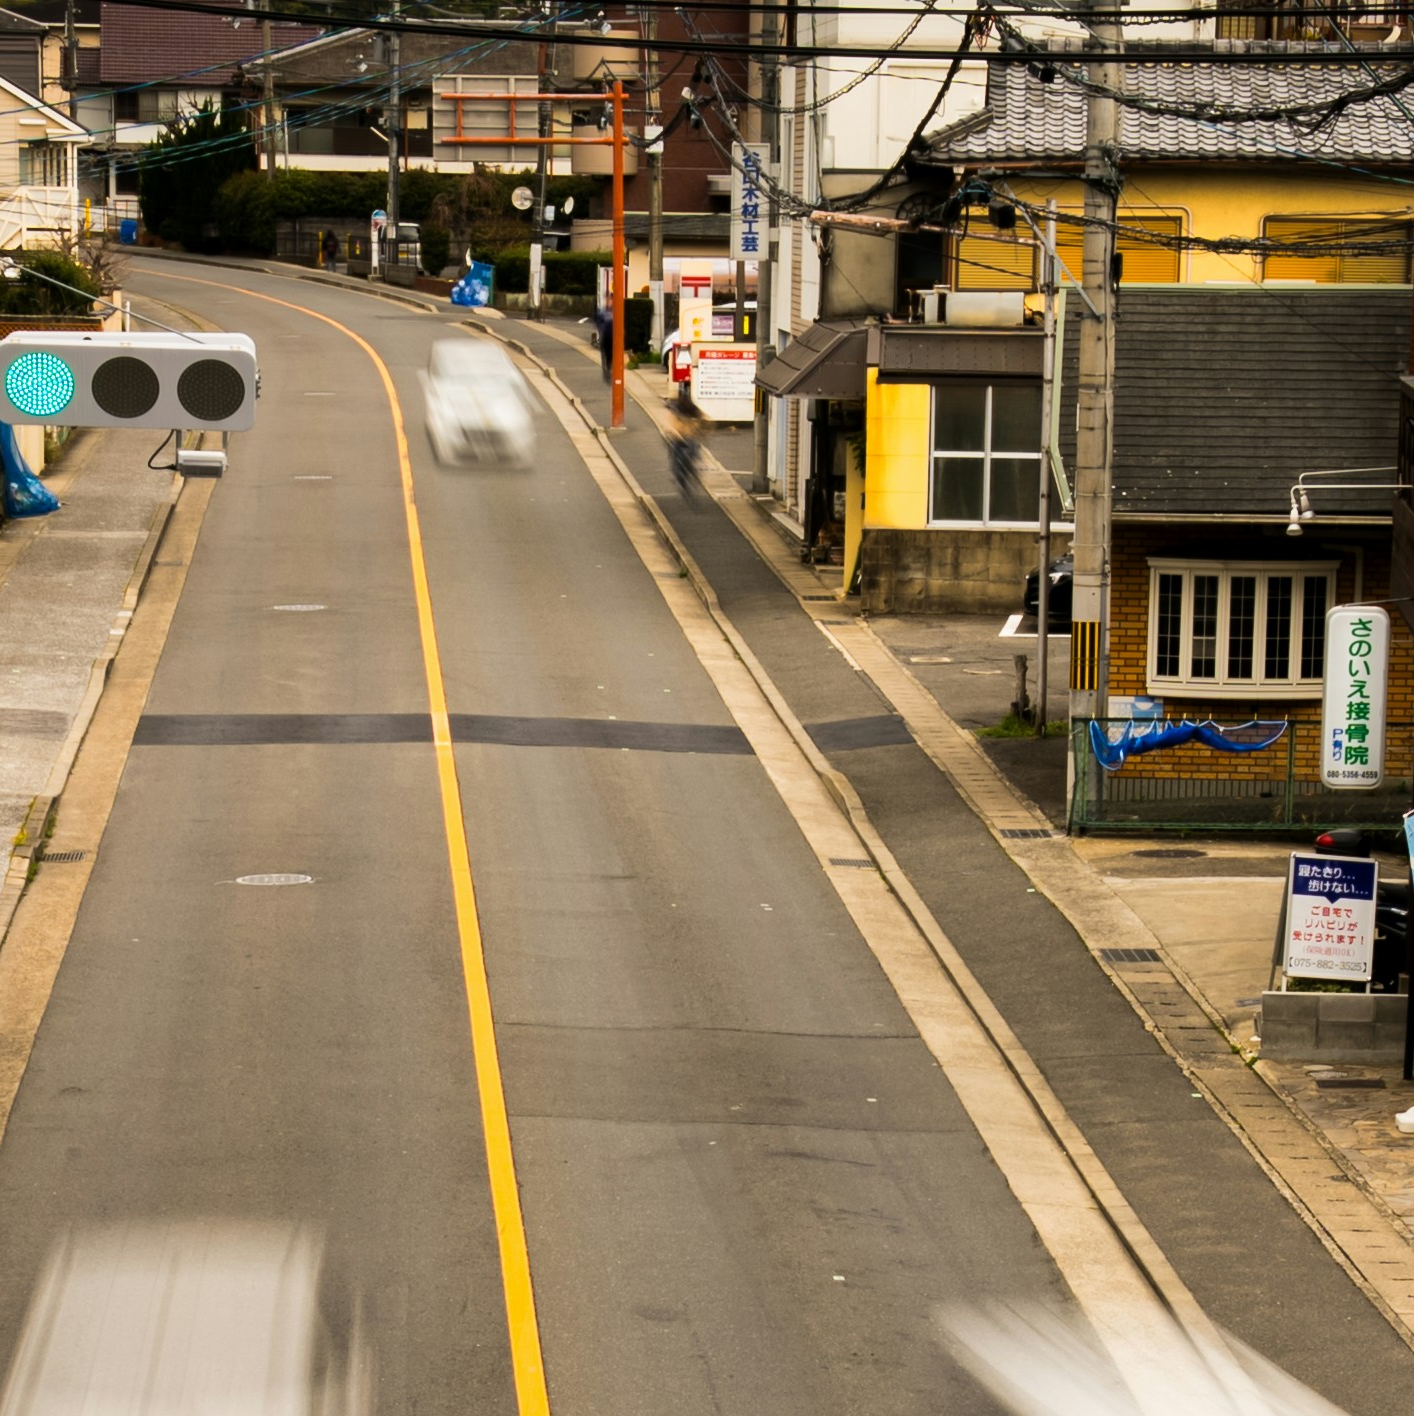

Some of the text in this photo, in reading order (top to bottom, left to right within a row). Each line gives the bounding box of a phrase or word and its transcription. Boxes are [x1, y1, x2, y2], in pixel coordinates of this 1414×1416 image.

[1344, 618, 1373, 766] さのいえ接骨院
[1311, 905, 1353, 918] ご自宅で
[1305, 919, 1358, 932] リハビリが
